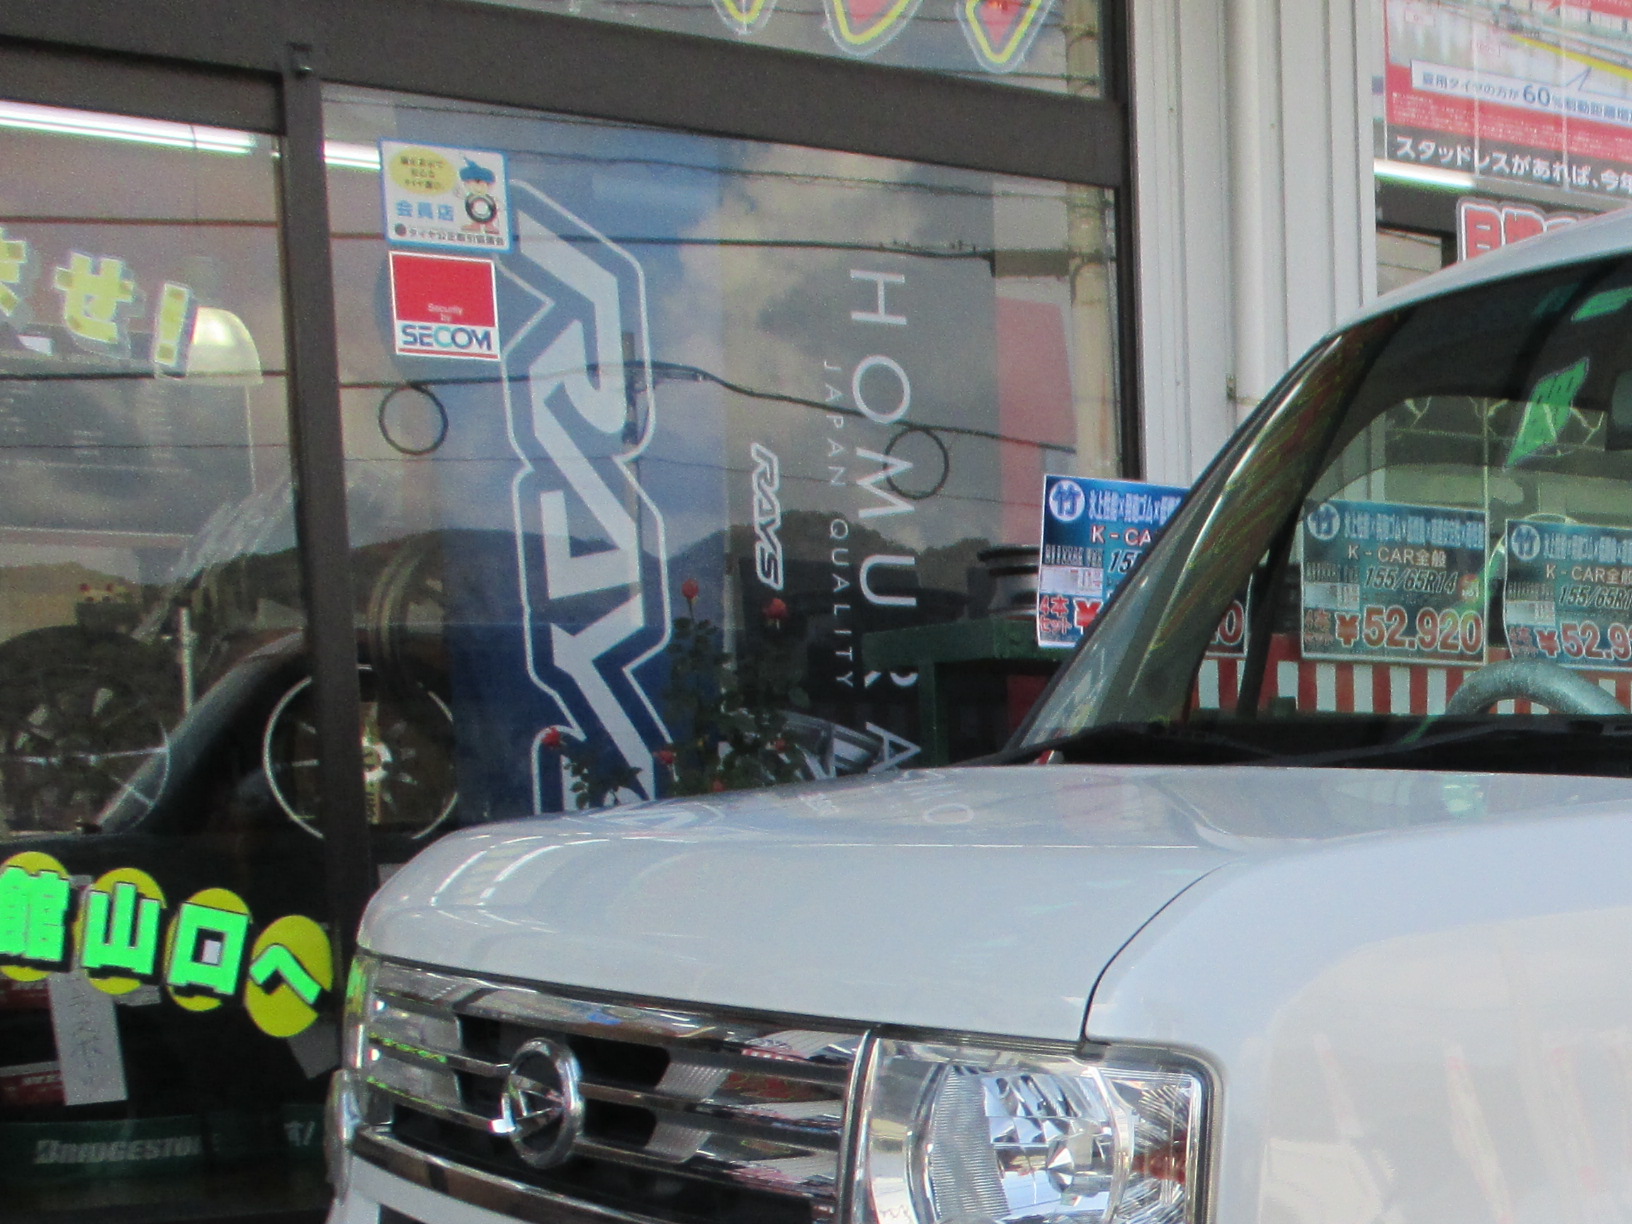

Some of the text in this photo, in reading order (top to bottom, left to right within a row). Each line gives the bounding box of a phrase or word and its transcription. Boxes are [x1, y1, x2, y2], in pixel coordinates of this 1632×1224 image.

[396, 199, 455, 222] 会員店
[427, 303, 464, 316] Security
[440, 313, 452, 323] by
[401, 323, 492, 351] SECOM
[751, 442, 784, 591] RAYS
[823, 359, 855, 689] JAPAN QUALITY
[1365, 565, 1458, 595] 155/65R14
[1040, 595, 1069, 617] 4本
[1040, 617, 1073, 634] セット
